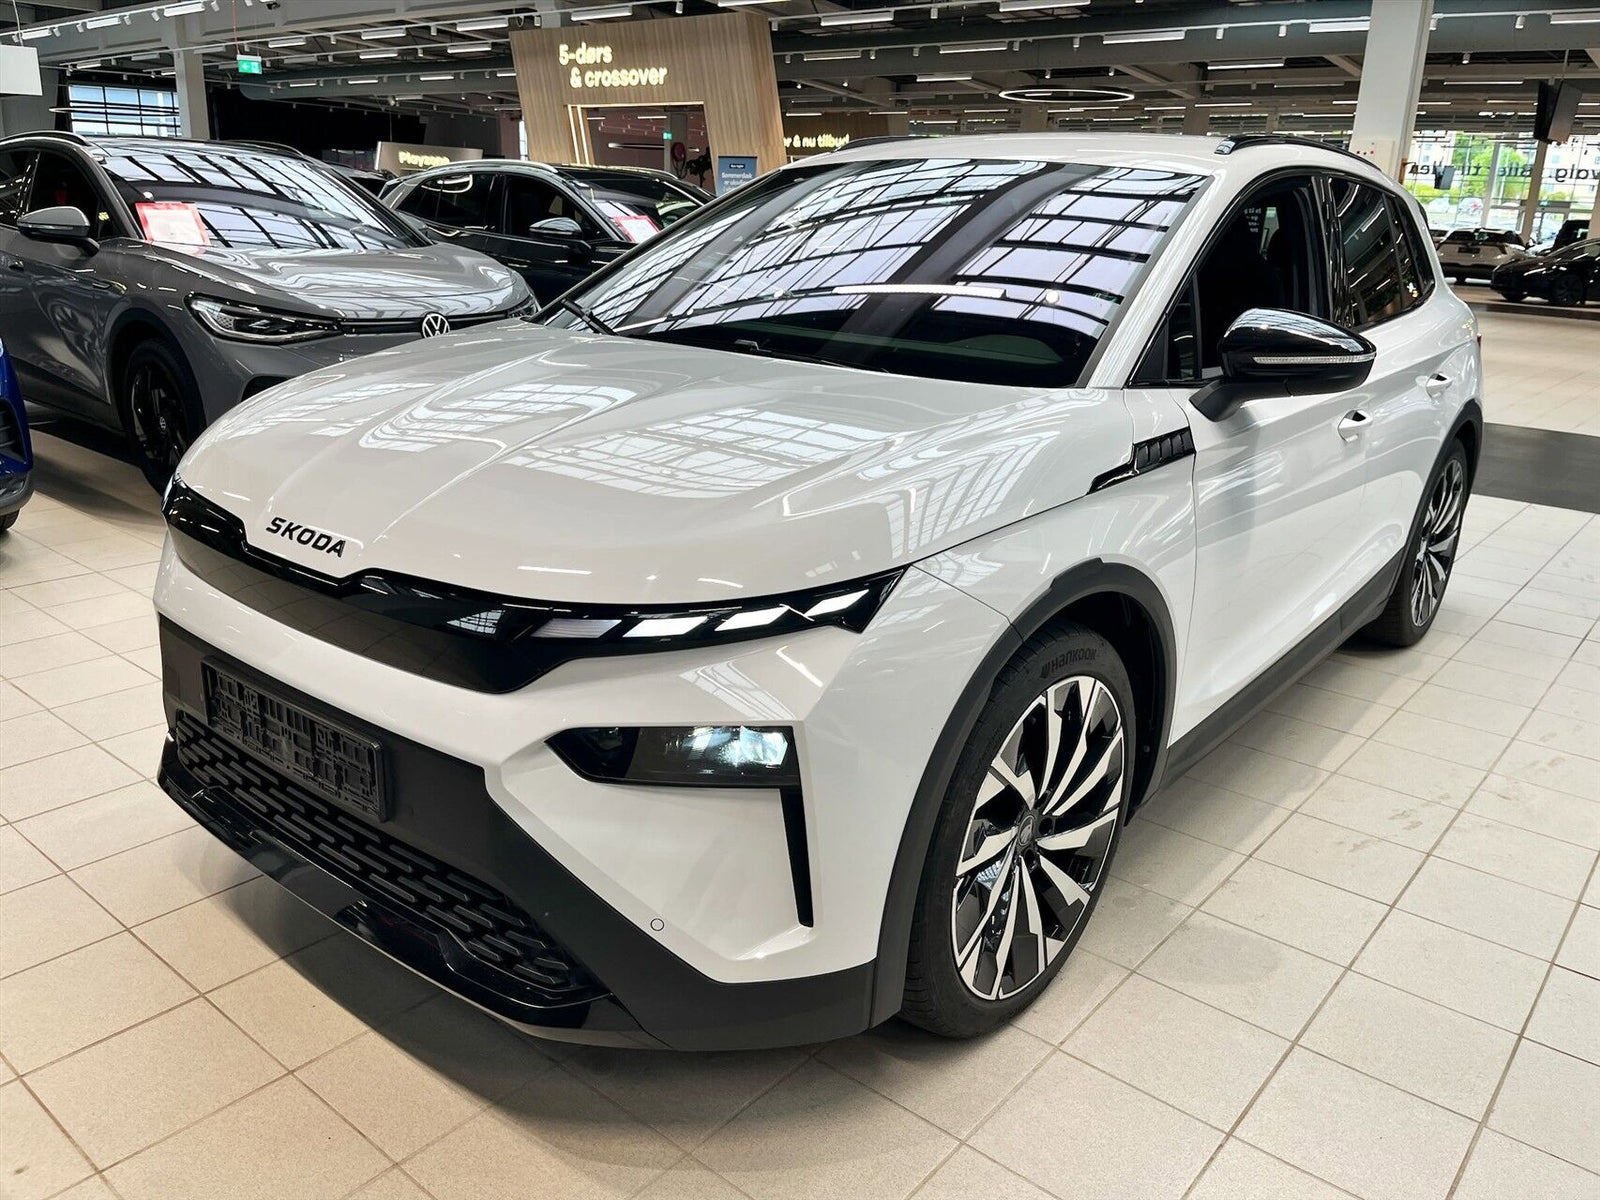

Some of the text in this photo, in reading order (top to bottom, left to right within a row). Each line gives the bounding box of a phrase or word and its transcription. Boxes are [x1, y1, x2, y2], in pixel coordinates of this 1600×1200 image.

[558, 41, 613, 66] 5-dørs
[569, 66, 668, 88] & crossover
[792, 134, 802, 148] &
[802, 137, 816, 148] nu
